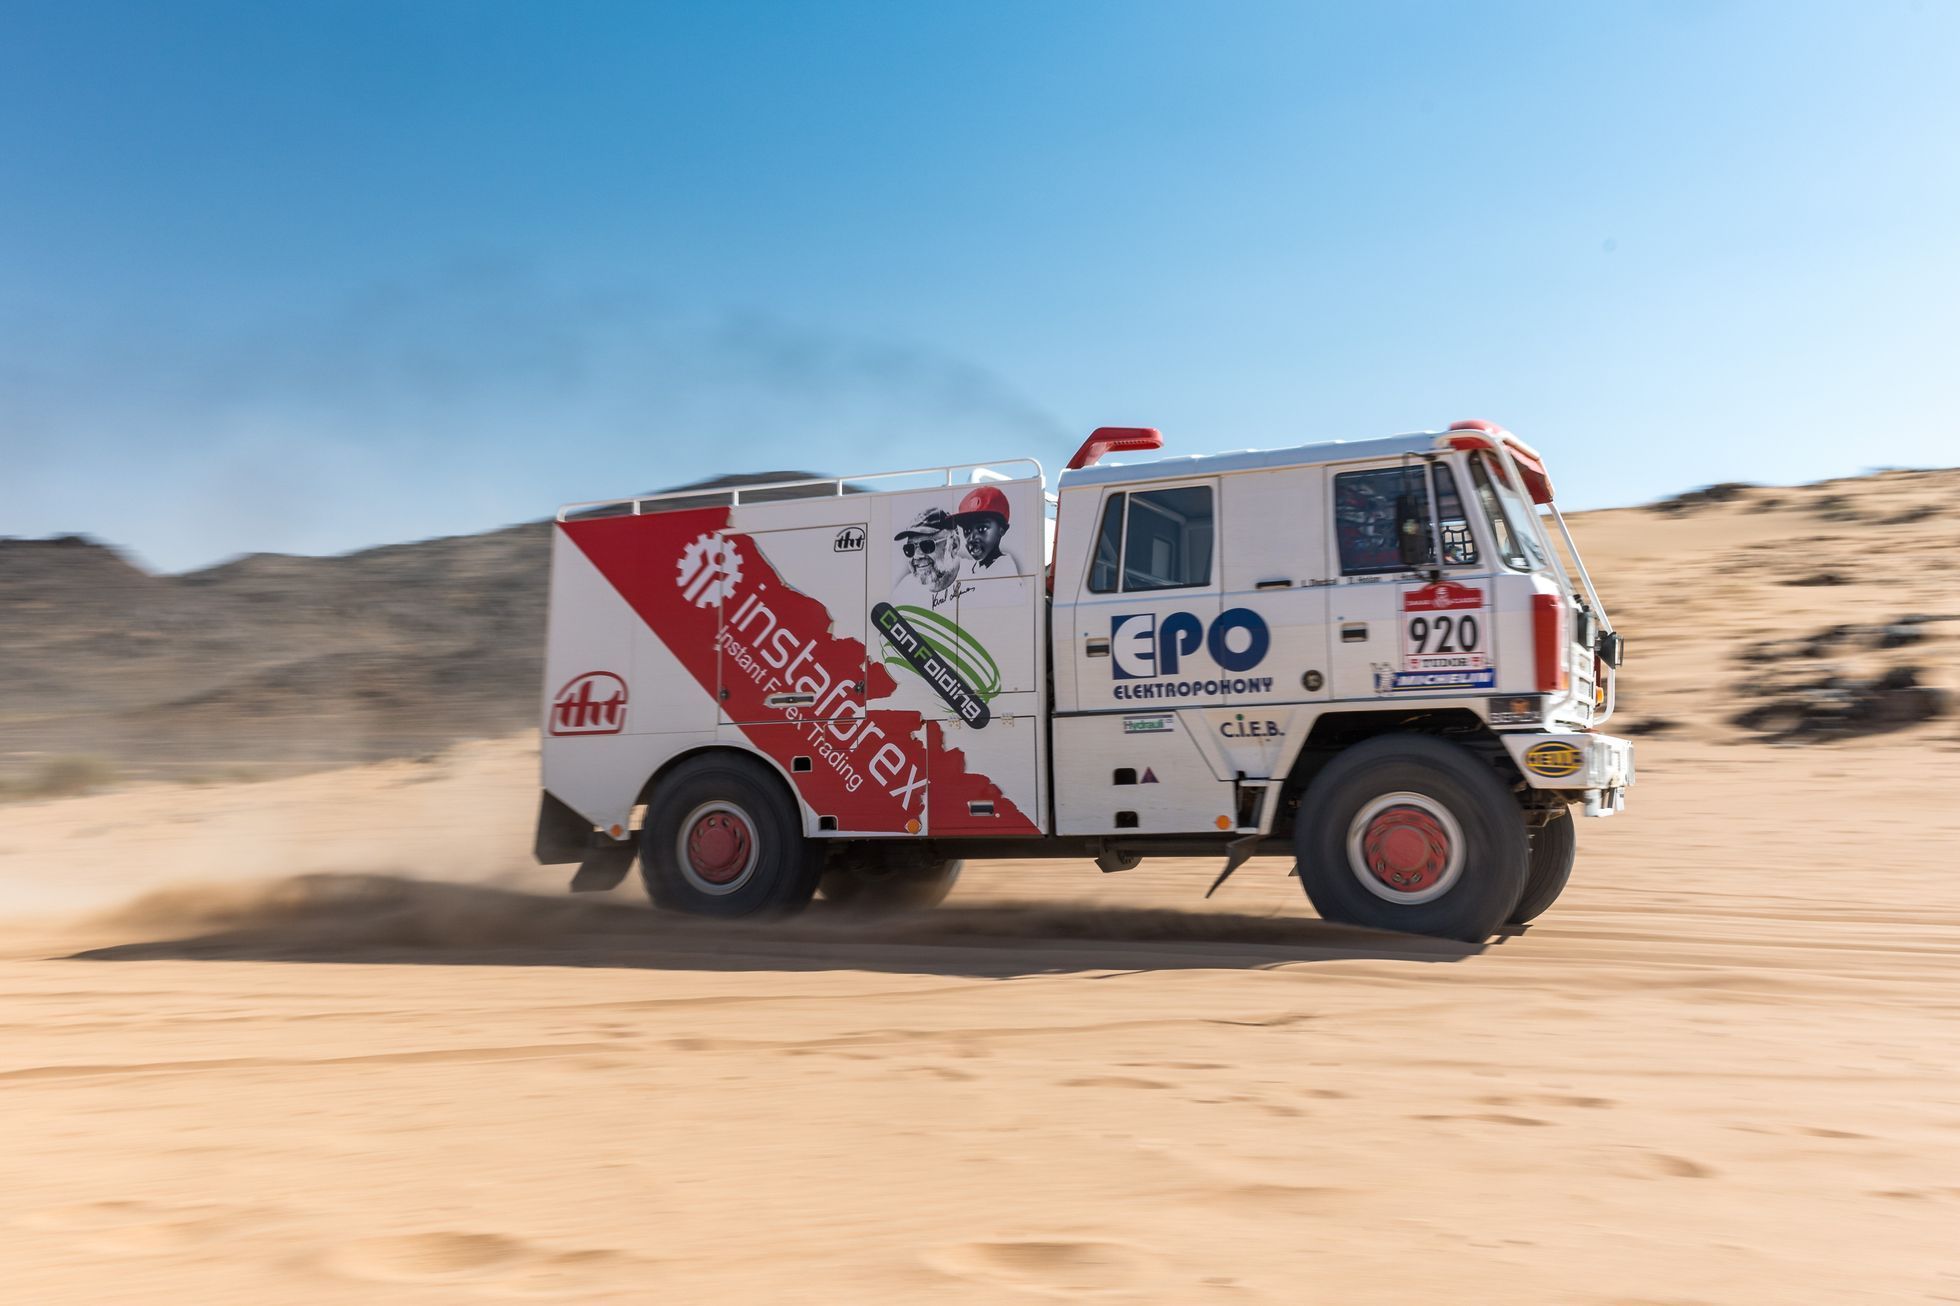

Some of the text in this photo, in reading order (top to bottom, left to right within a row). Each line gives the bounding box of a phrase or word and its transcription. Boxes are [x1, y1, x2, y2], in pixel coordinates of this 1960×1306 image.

[1111, 607, 1270, 680] EPO
[1409, 614, 1478, 654] 920
[714, 625, 864, 792] Instant Fex Trading
[730, 583, 928, 811] instaforex
[1113, 677, 1274, 700] ELEKTROPOHONY
